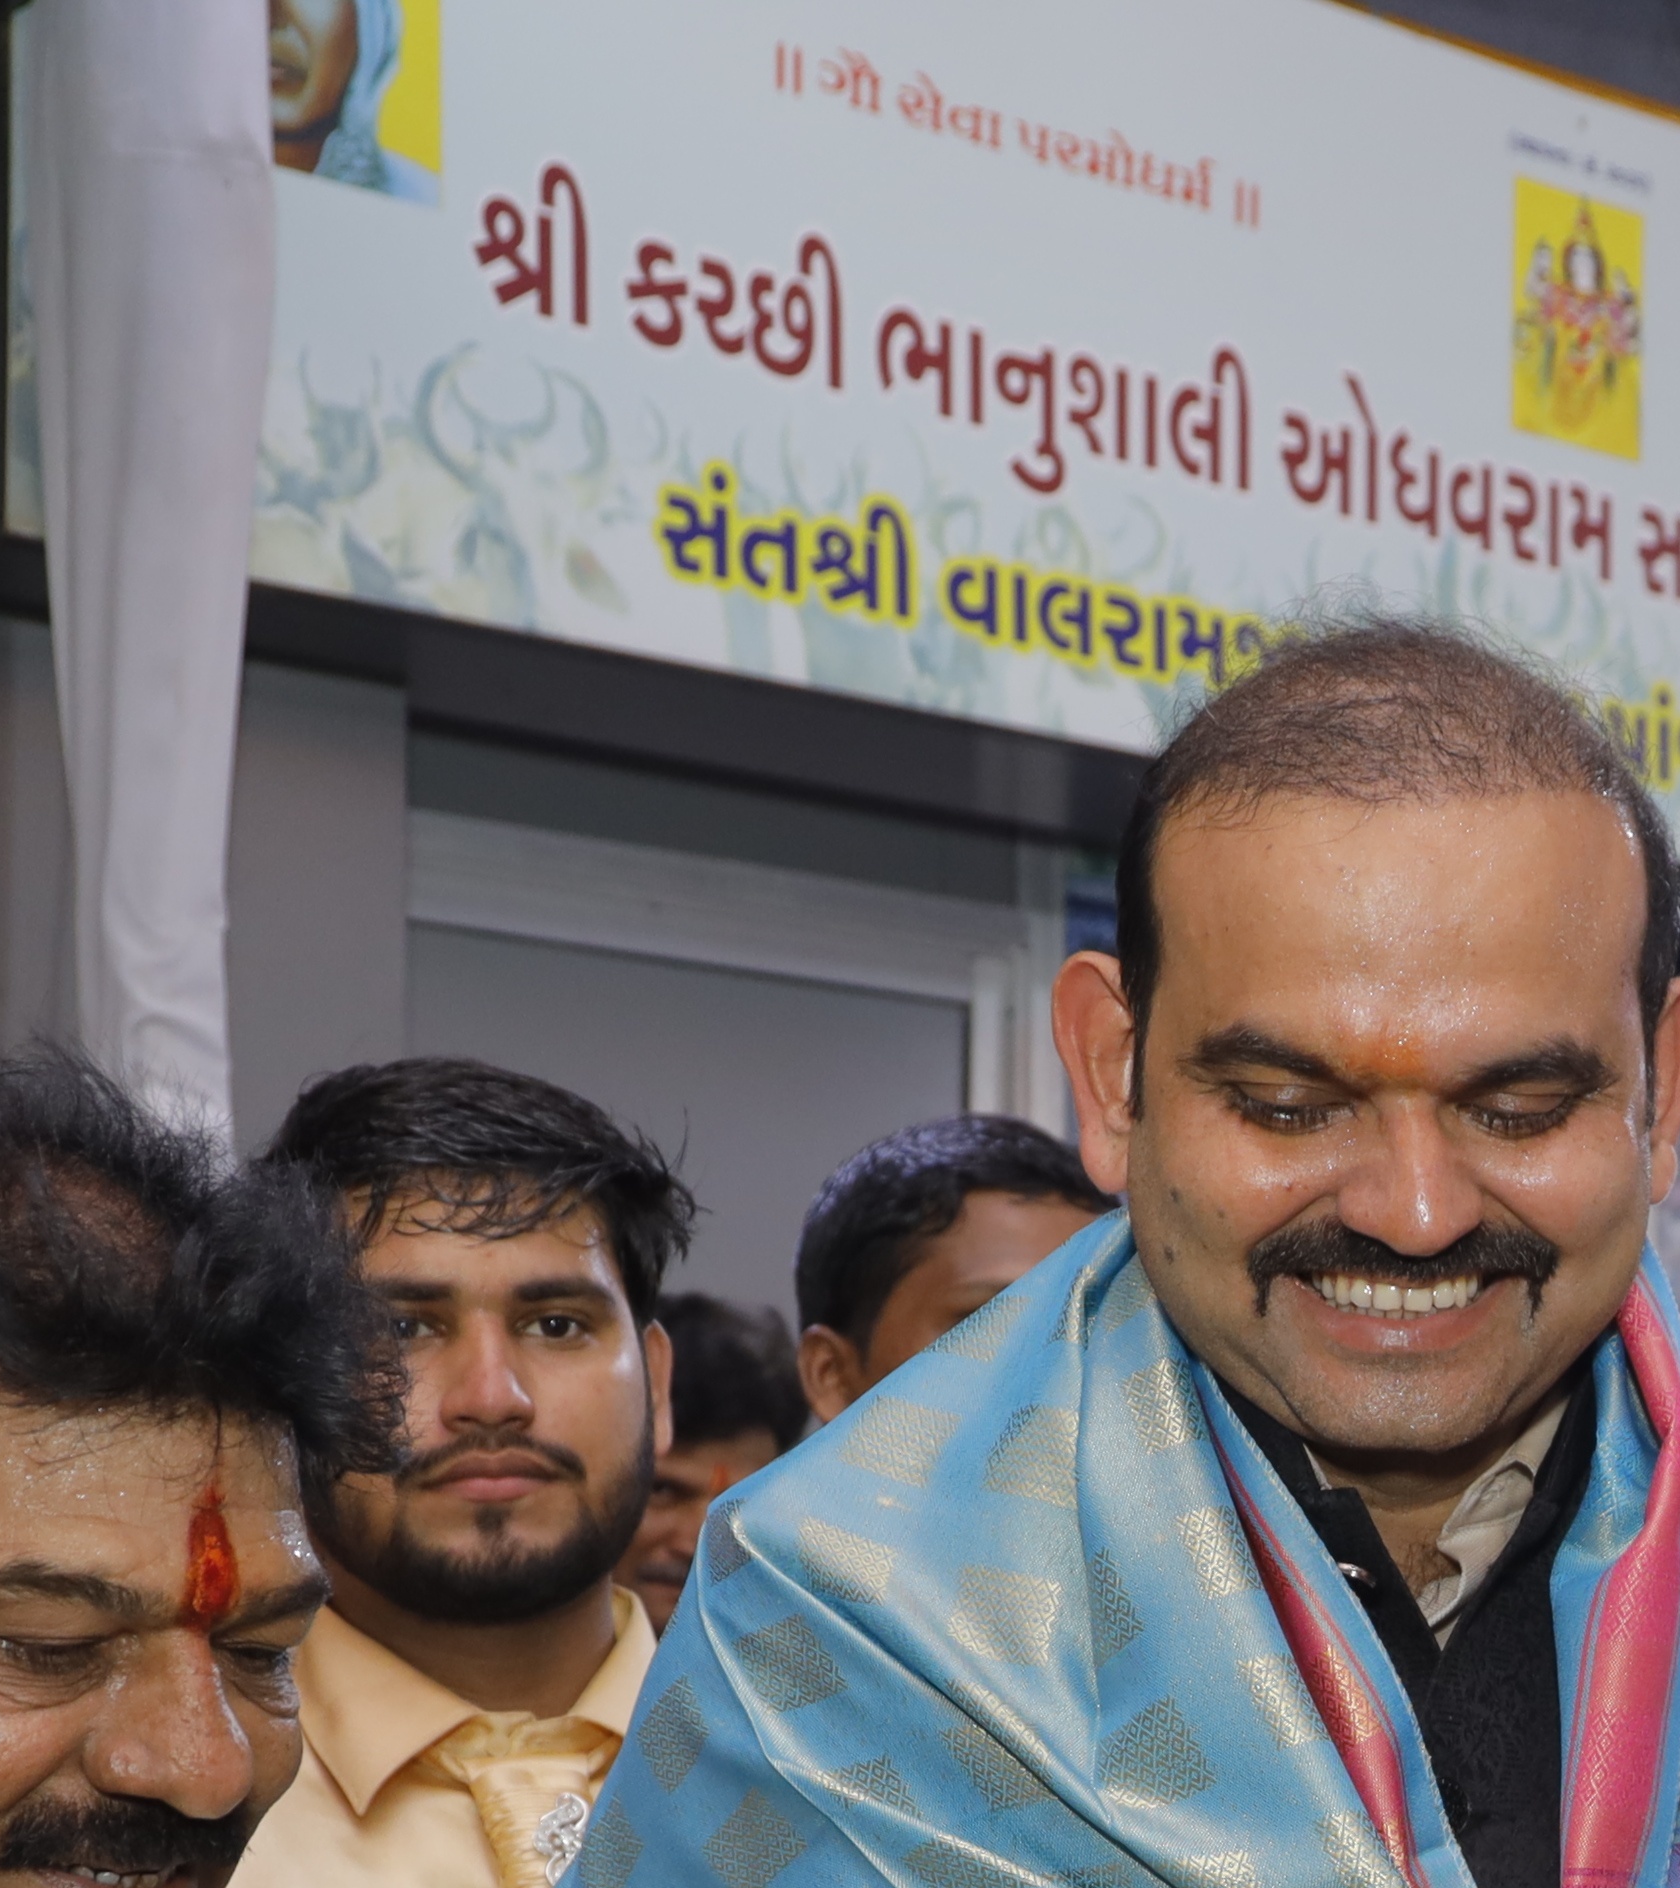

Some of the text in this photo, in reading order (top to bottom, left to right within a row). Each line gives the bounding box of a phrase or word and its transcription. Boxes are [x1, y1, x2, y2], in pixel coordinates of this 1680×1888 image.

[897, 68, 1004, 150] સેવા
[1016, 117, 1219, 212] પરમોધર્મ
[475, 163, 590, 326] શ્રી
[878, 309, 1252, 494] ભાનુશાલી
[1280, 371, 1612, 580] ઓધવરામ
[660, 466, 915, 622] સંતશ્રી
